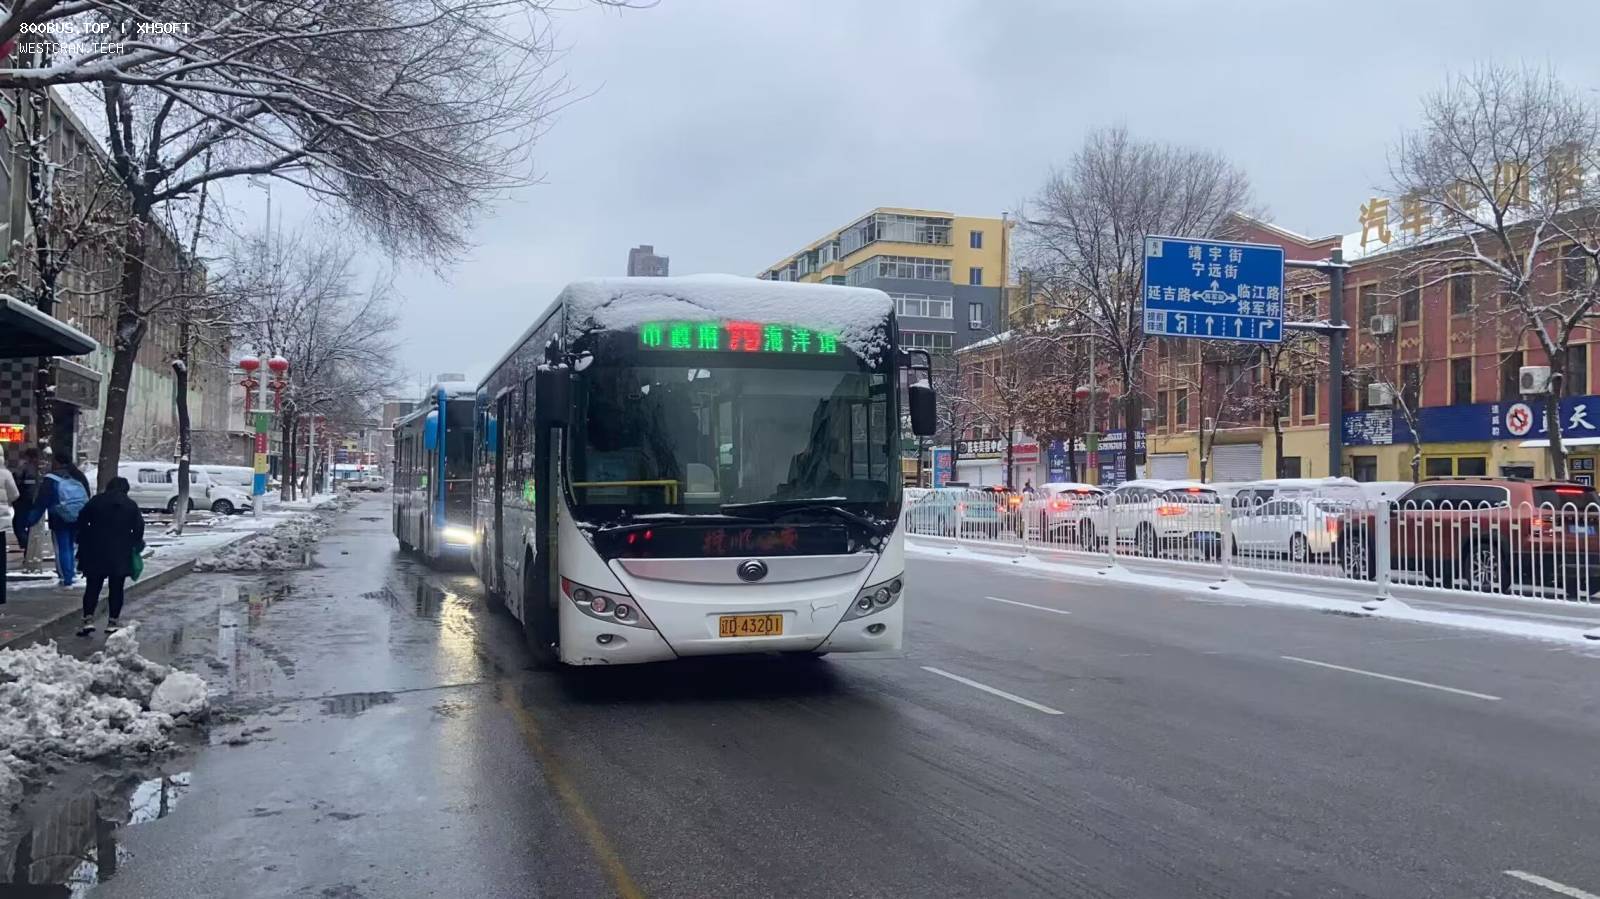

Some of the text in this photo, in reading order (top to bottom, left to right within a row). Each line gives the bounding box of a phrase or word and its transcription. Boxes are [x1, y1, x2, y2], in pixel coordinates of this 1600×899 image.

[1188, 245, 1242, 263] 靖宇街
[1192, 262, 1238, 279] 宁远街
[1147, 285, 1191, 302] 延吉路
[1237, 283, 1280, 301] 临江路
[1237, 300, 1280, 317] 将军桥
